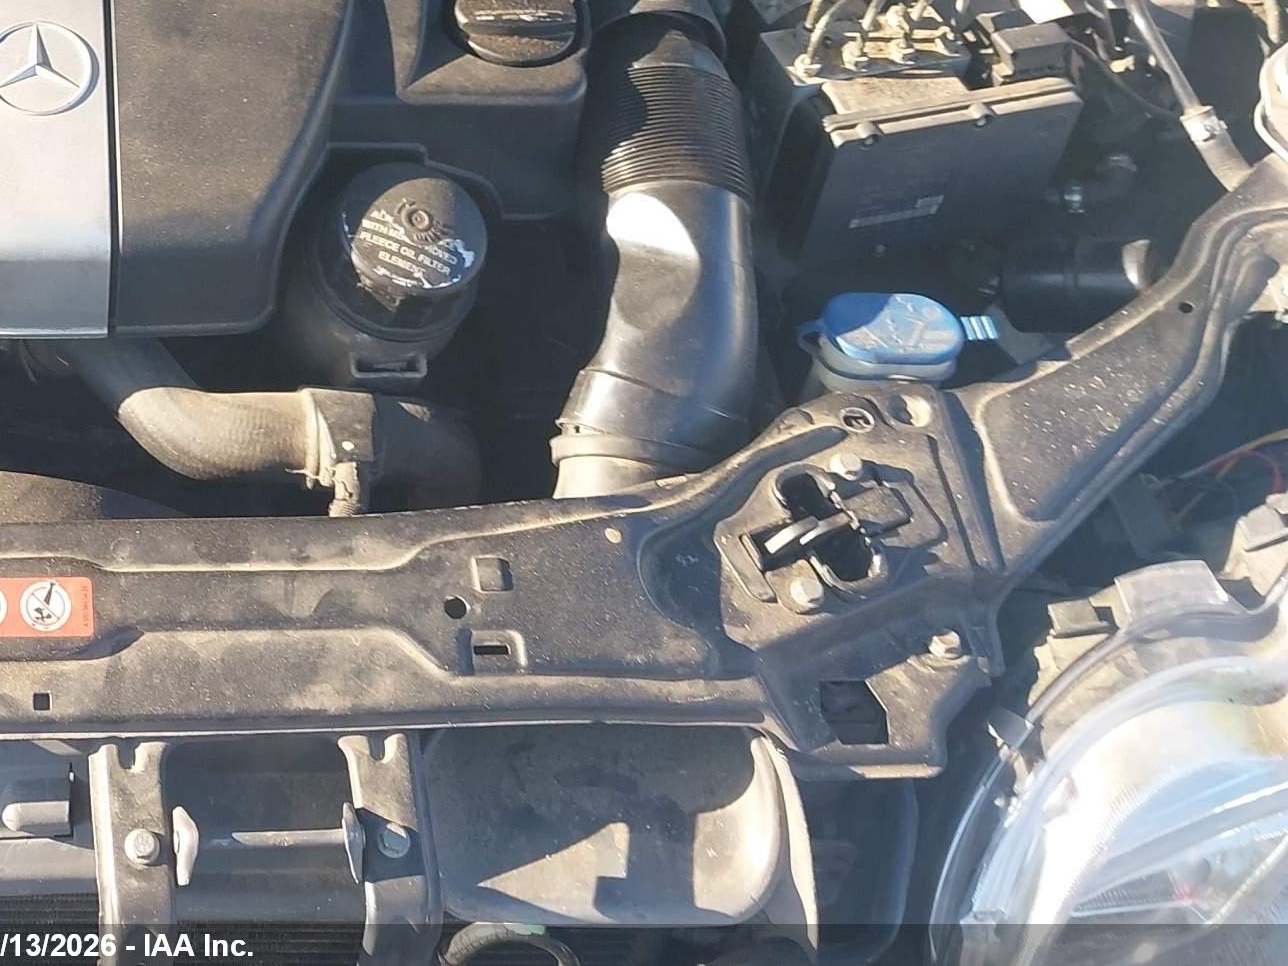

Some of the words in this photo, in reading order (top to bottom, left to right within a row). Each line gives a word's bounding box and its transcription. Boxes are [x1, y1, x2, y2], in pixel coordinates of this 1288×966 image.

[359, 231, 400, 252] FLEECE
[400, 245, 416, 260] OIL
[417, 253, 451, 275] FILTER
